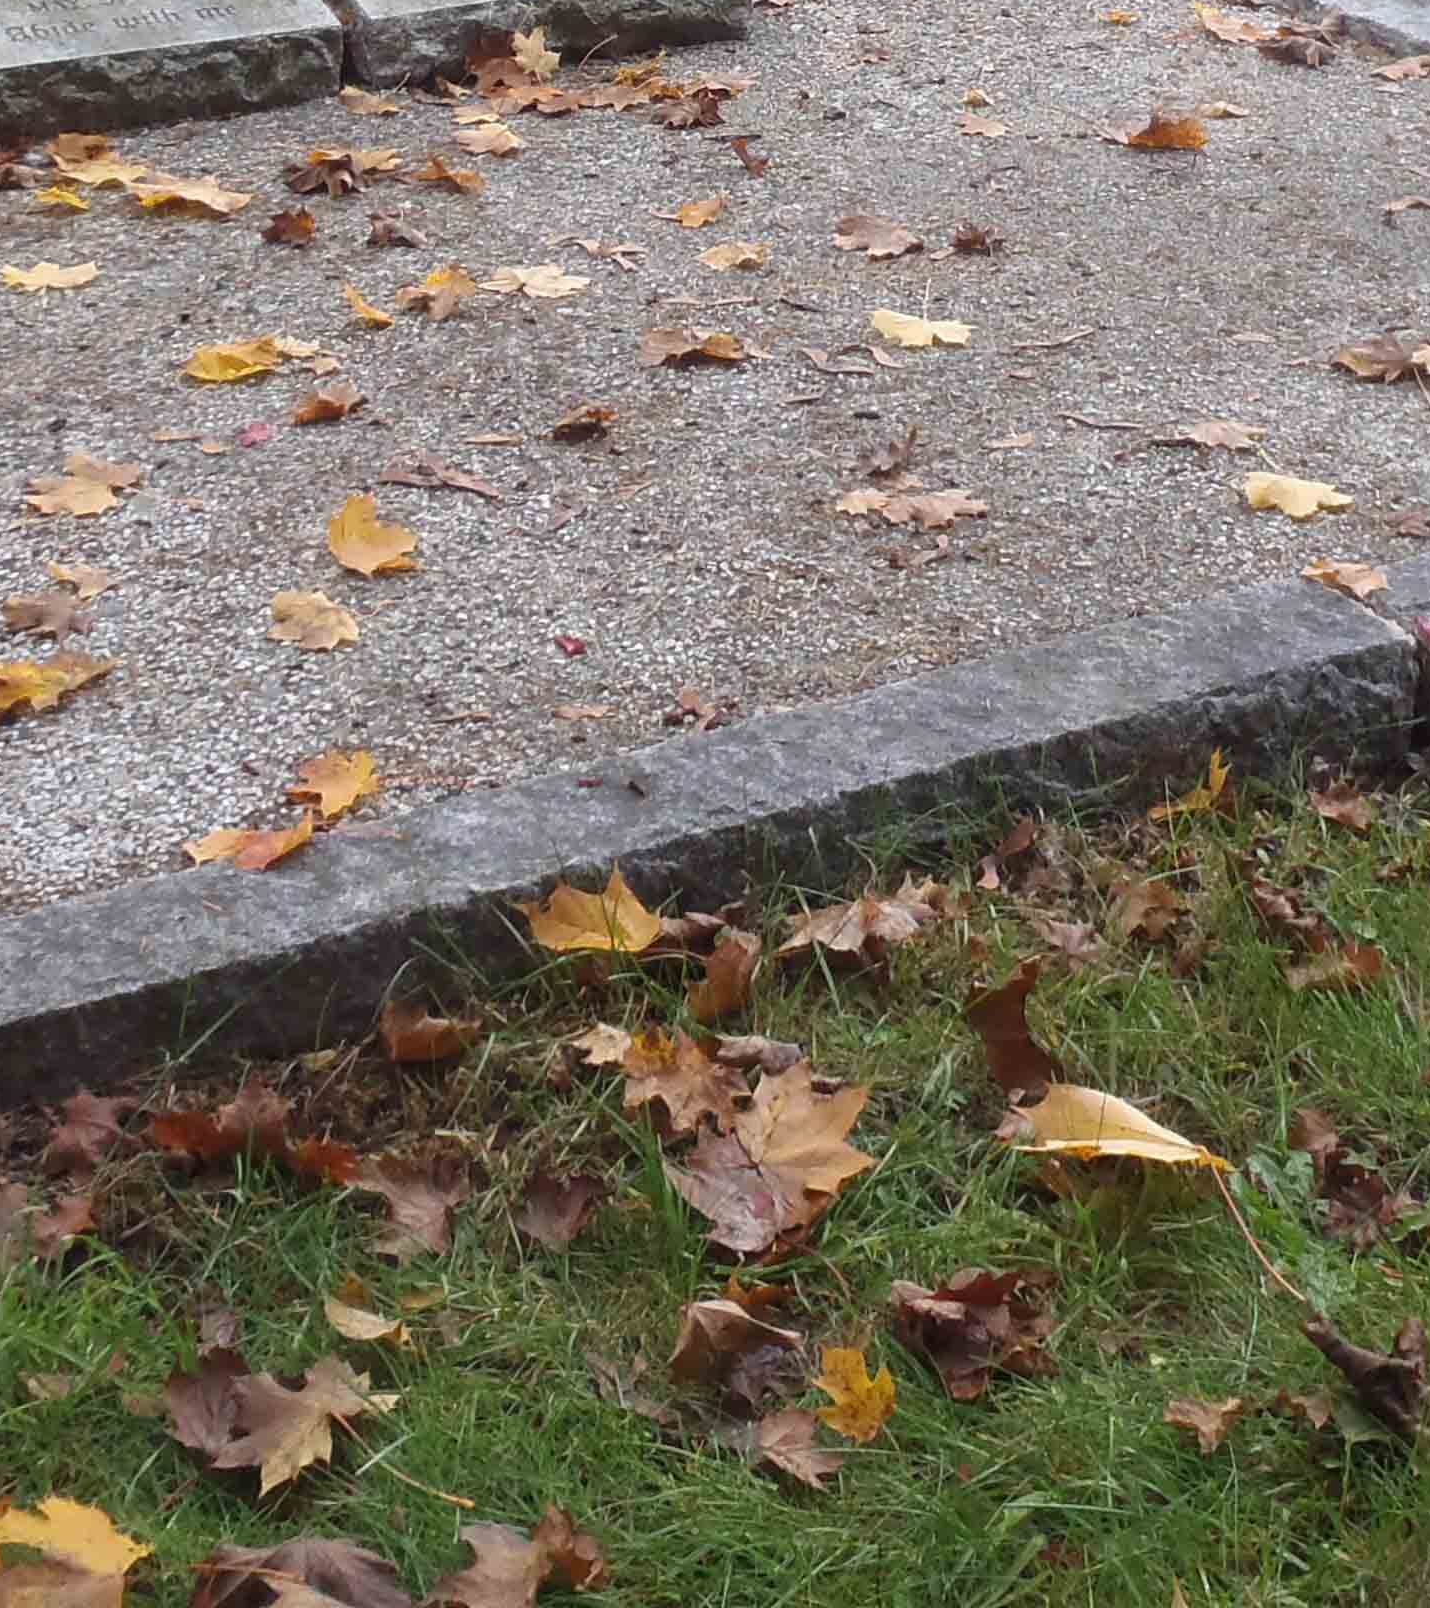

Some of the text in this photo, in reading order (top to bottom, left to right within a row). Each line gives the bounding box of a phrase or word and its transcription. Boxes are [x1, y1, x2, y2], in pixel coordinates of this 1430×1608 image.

[5, 4, 237, 43] Abide with me
